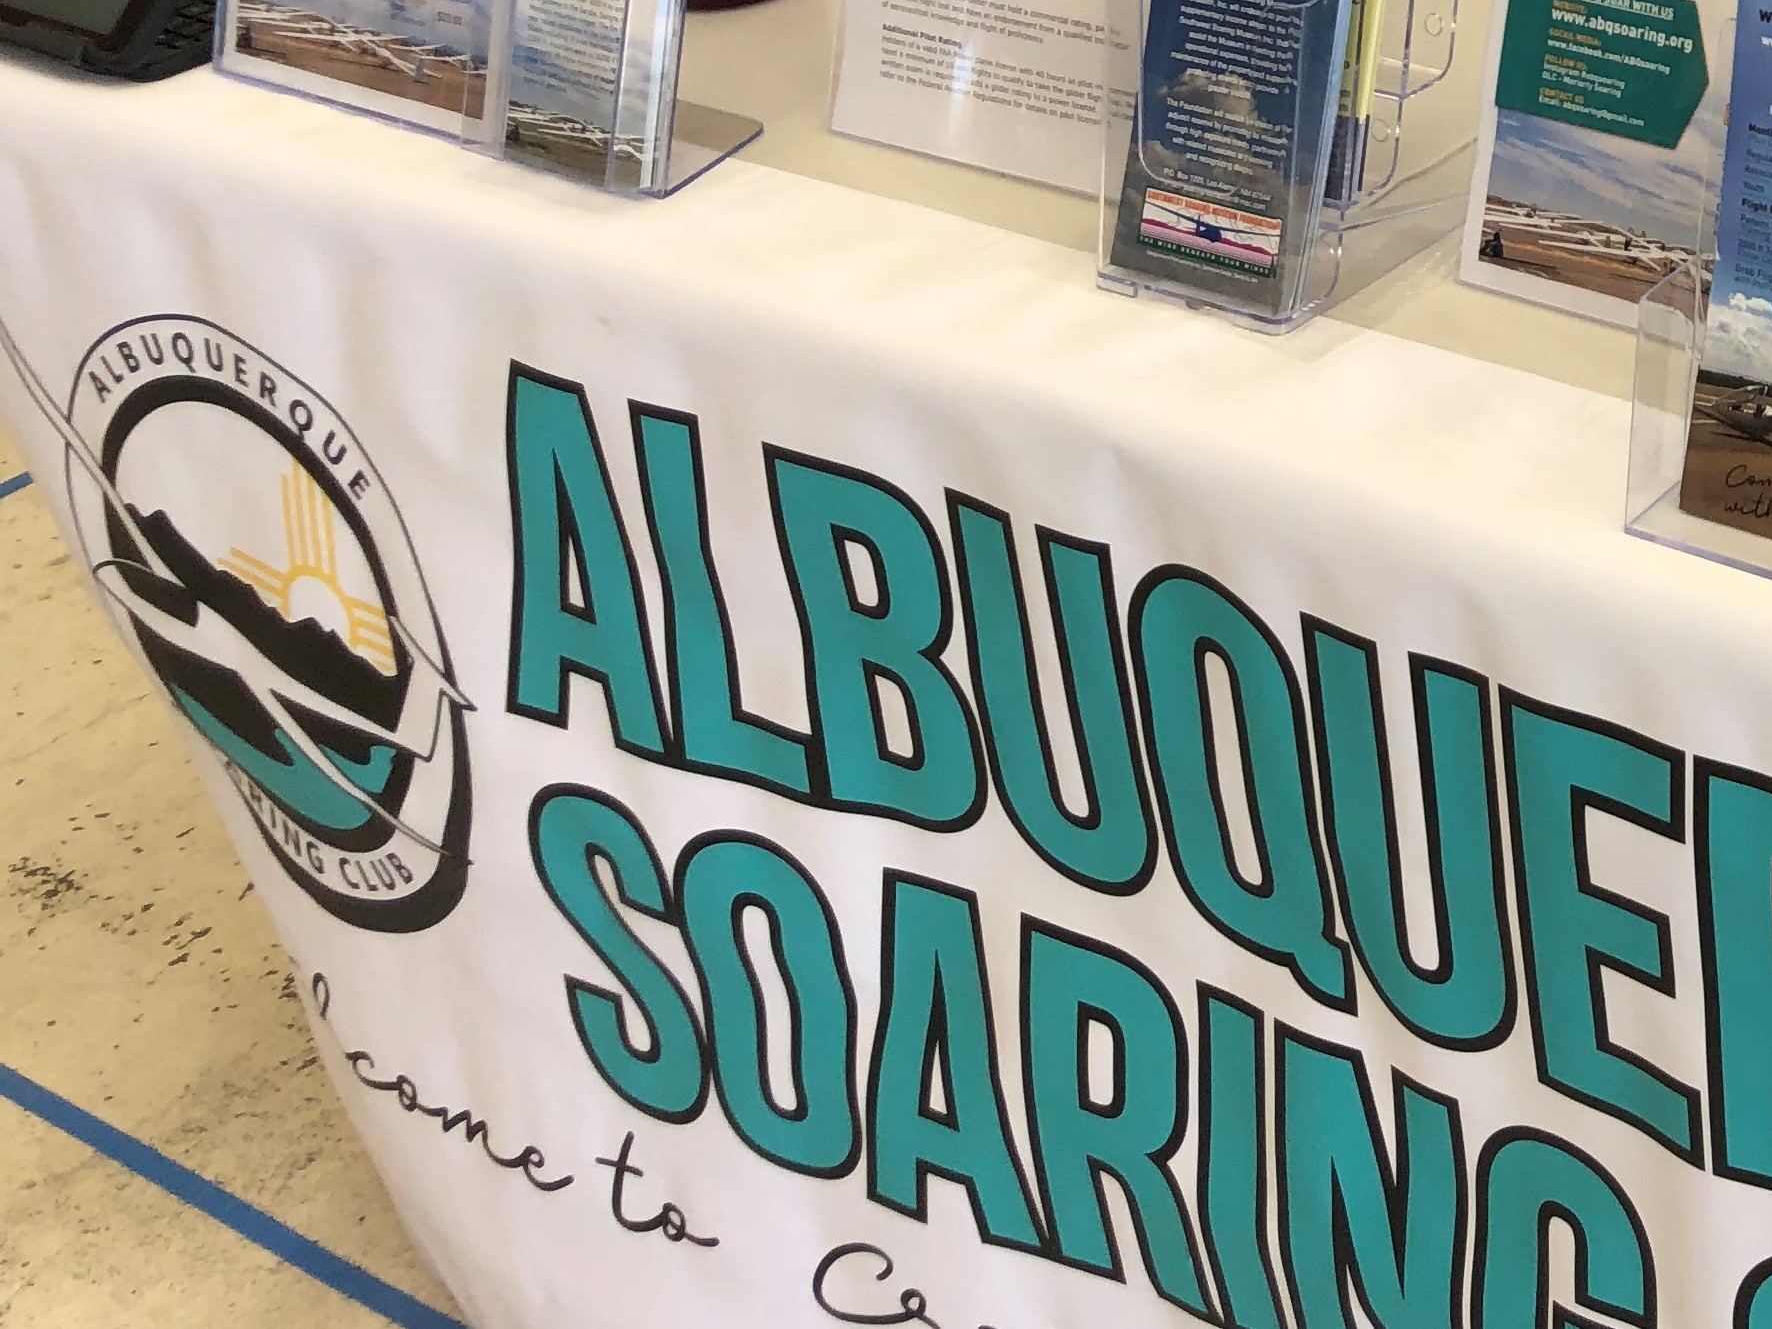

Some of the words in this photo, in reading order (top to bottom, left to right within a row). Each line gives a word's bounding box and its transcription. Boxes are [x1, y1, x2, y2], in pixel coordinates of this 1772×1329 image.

[1551, 8, 1693, 53] www.abqsoaring.org
[1632, 0, 1659, 17] WITH
[1660, 6, 1675, 20] US
[88, 332, 374, 502] ALBUQUERQUE
[338, 852, 414, 892] CLUB
[531, 779, 1657, 1329] SOARING
[596, 1130, 720, 1248] to
